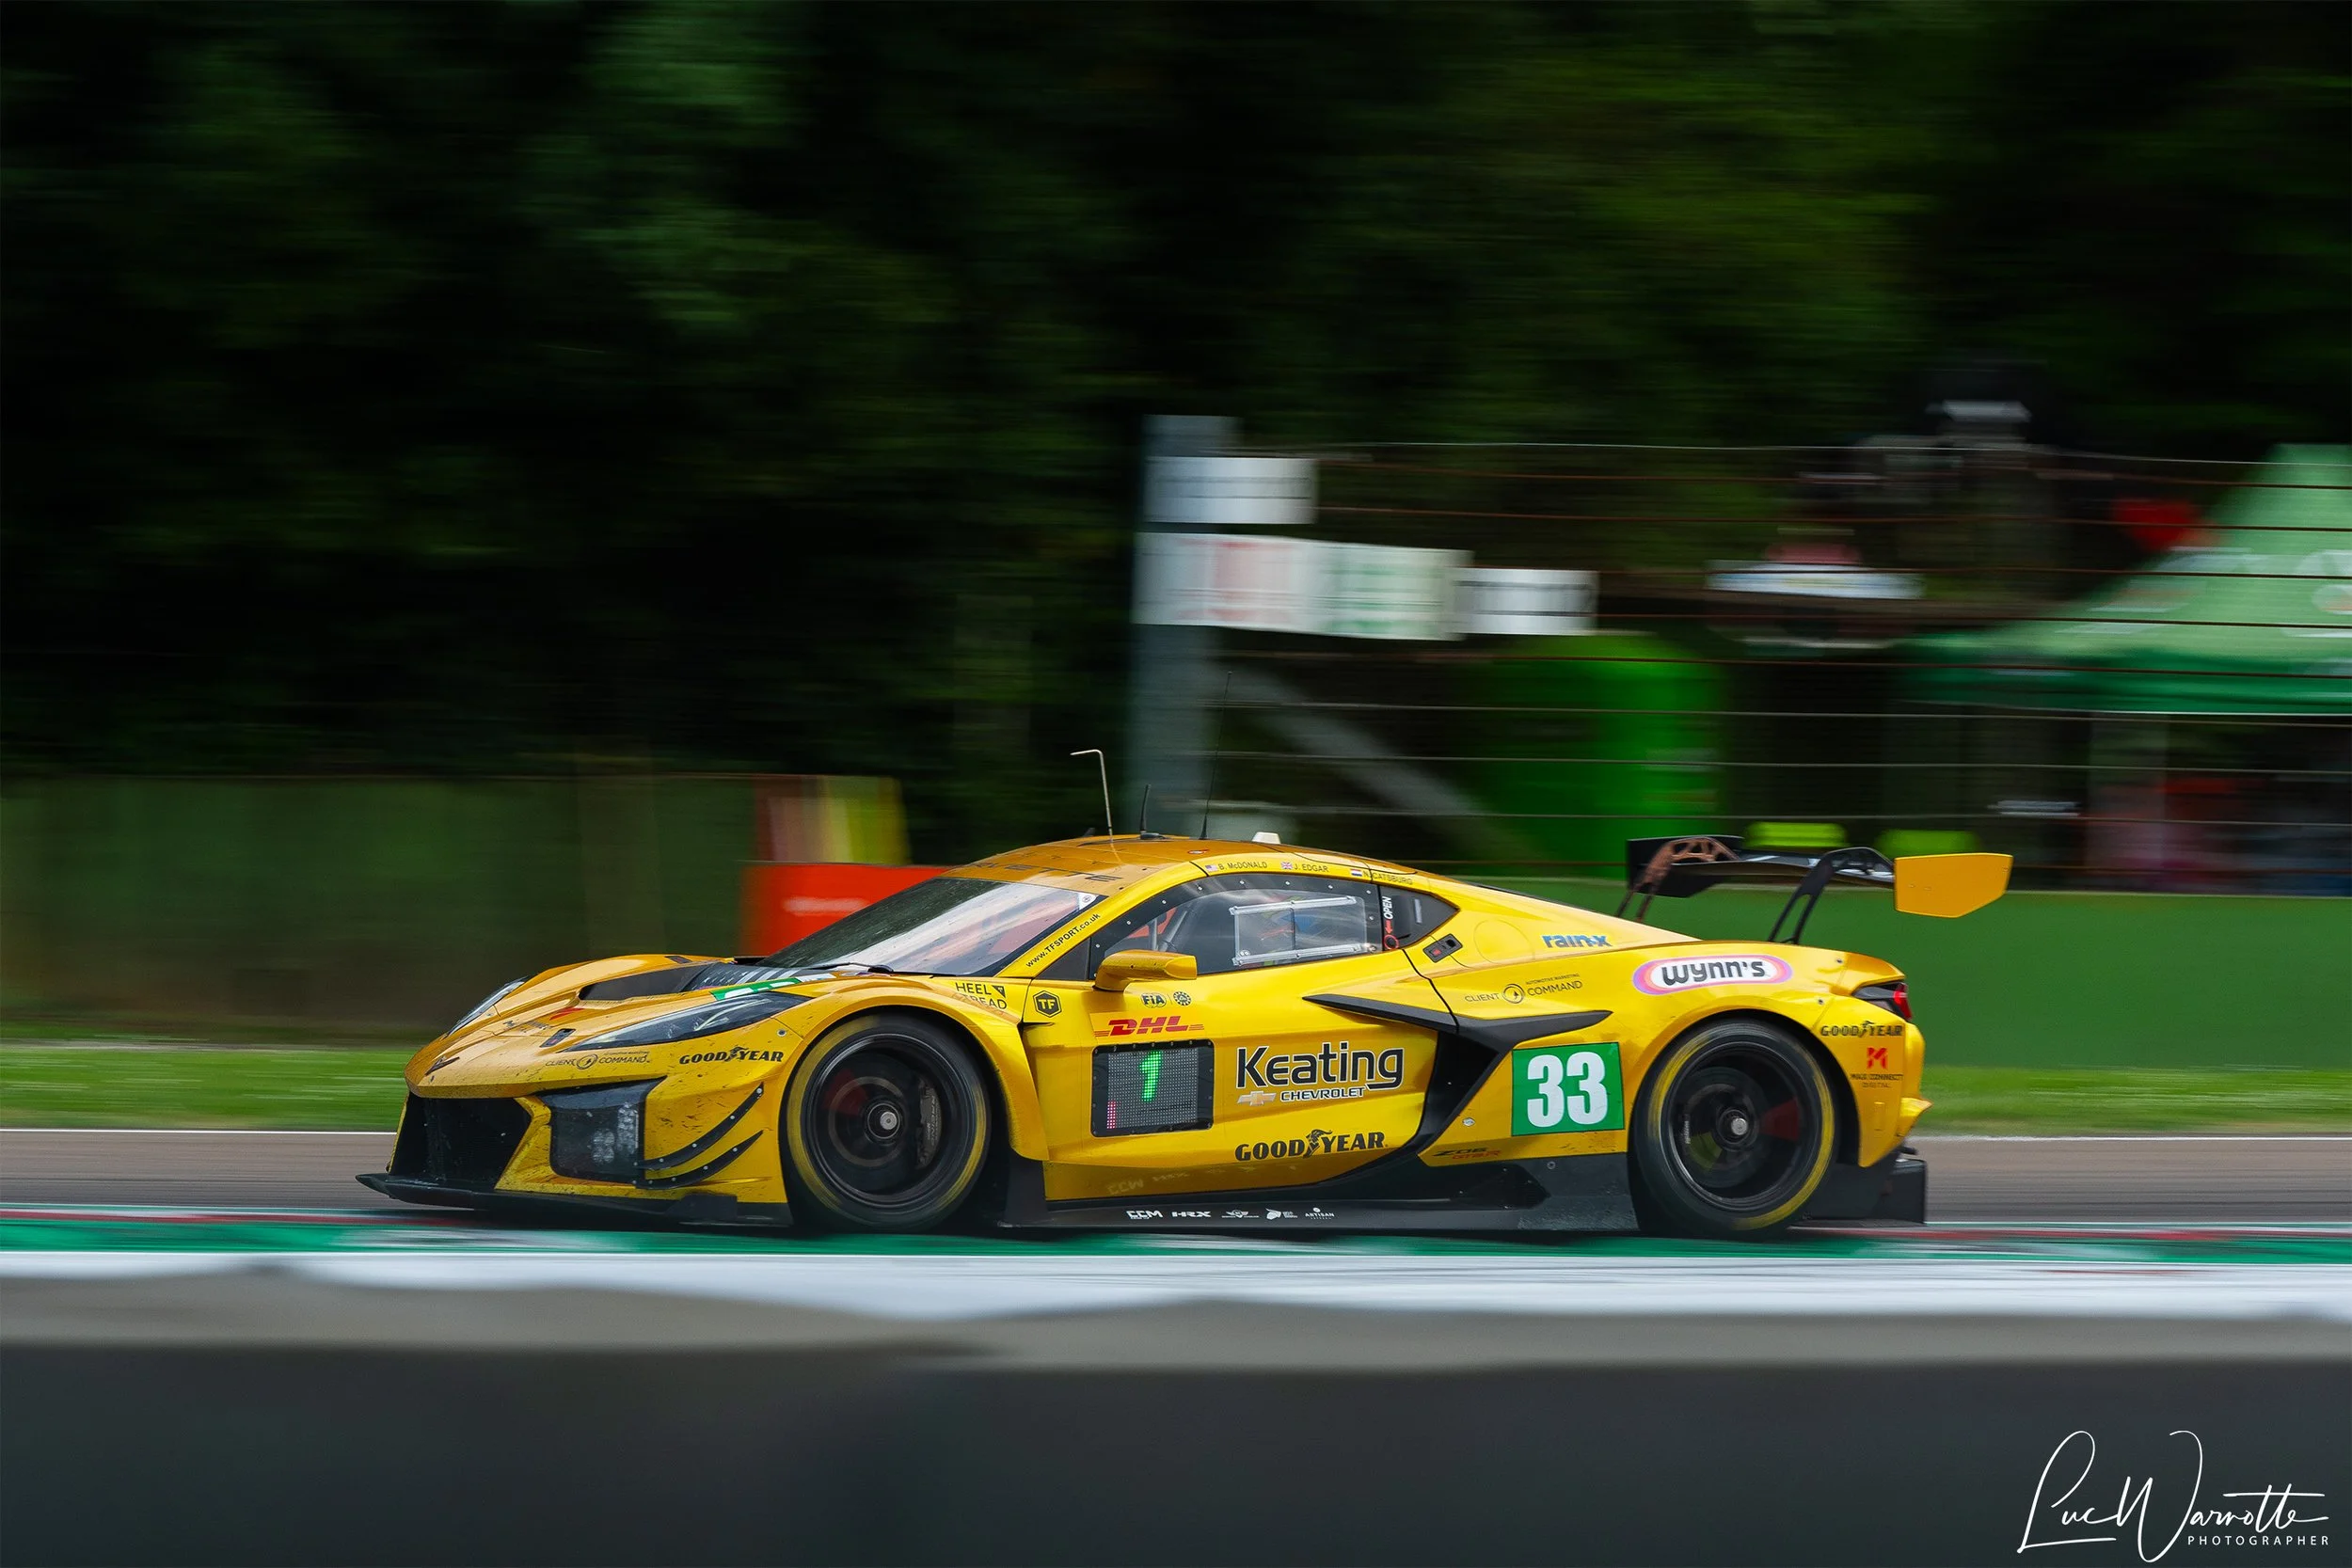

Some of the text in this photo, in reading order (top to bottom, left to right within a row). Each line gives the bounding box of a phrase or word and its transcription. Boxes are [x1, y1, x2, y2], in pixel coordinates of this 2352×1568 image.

[1303, 863, 1329, 873] EDGAR
[1381, 896, 1393, 920] OPEN
[1025, 913, 1101, 967] www.TFSPORT.co.uk
[955, 982, 992, 995] HEEL
[1464, 980, 1582, 1004] CLIENT COMMAND
[1038, 999, 1056, 1010] TF
[1108, 1016, 1189, 1037] DHL
[1138, 1050, 1162, 1102] 1
[1236, 1040, 1405, 1091] Keating
[1279, 1087, 1366, 1102] CHEVROLET
[1527, 1051, 1608, 1128] 33
